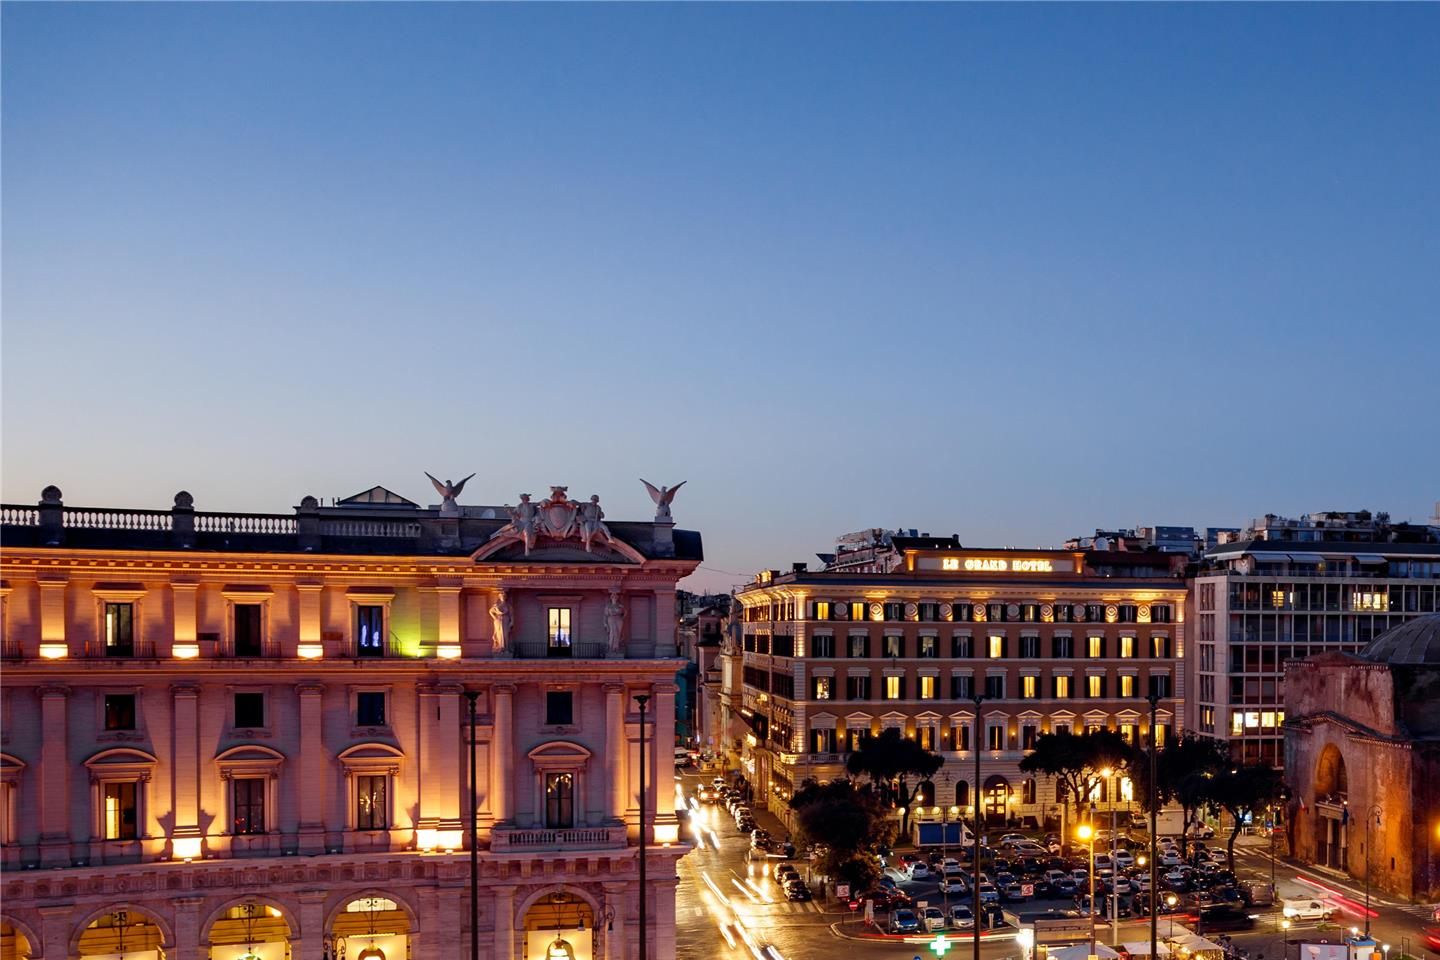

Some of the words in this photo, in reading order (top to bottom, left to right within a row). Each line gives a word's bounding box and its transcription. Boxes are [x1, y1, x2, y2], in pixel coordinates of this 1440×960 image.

[943, 559, 959, 570] LE
[965, 559, 1008, 571] GRAND
[1012, 560, 1053, 572] HOTEL
